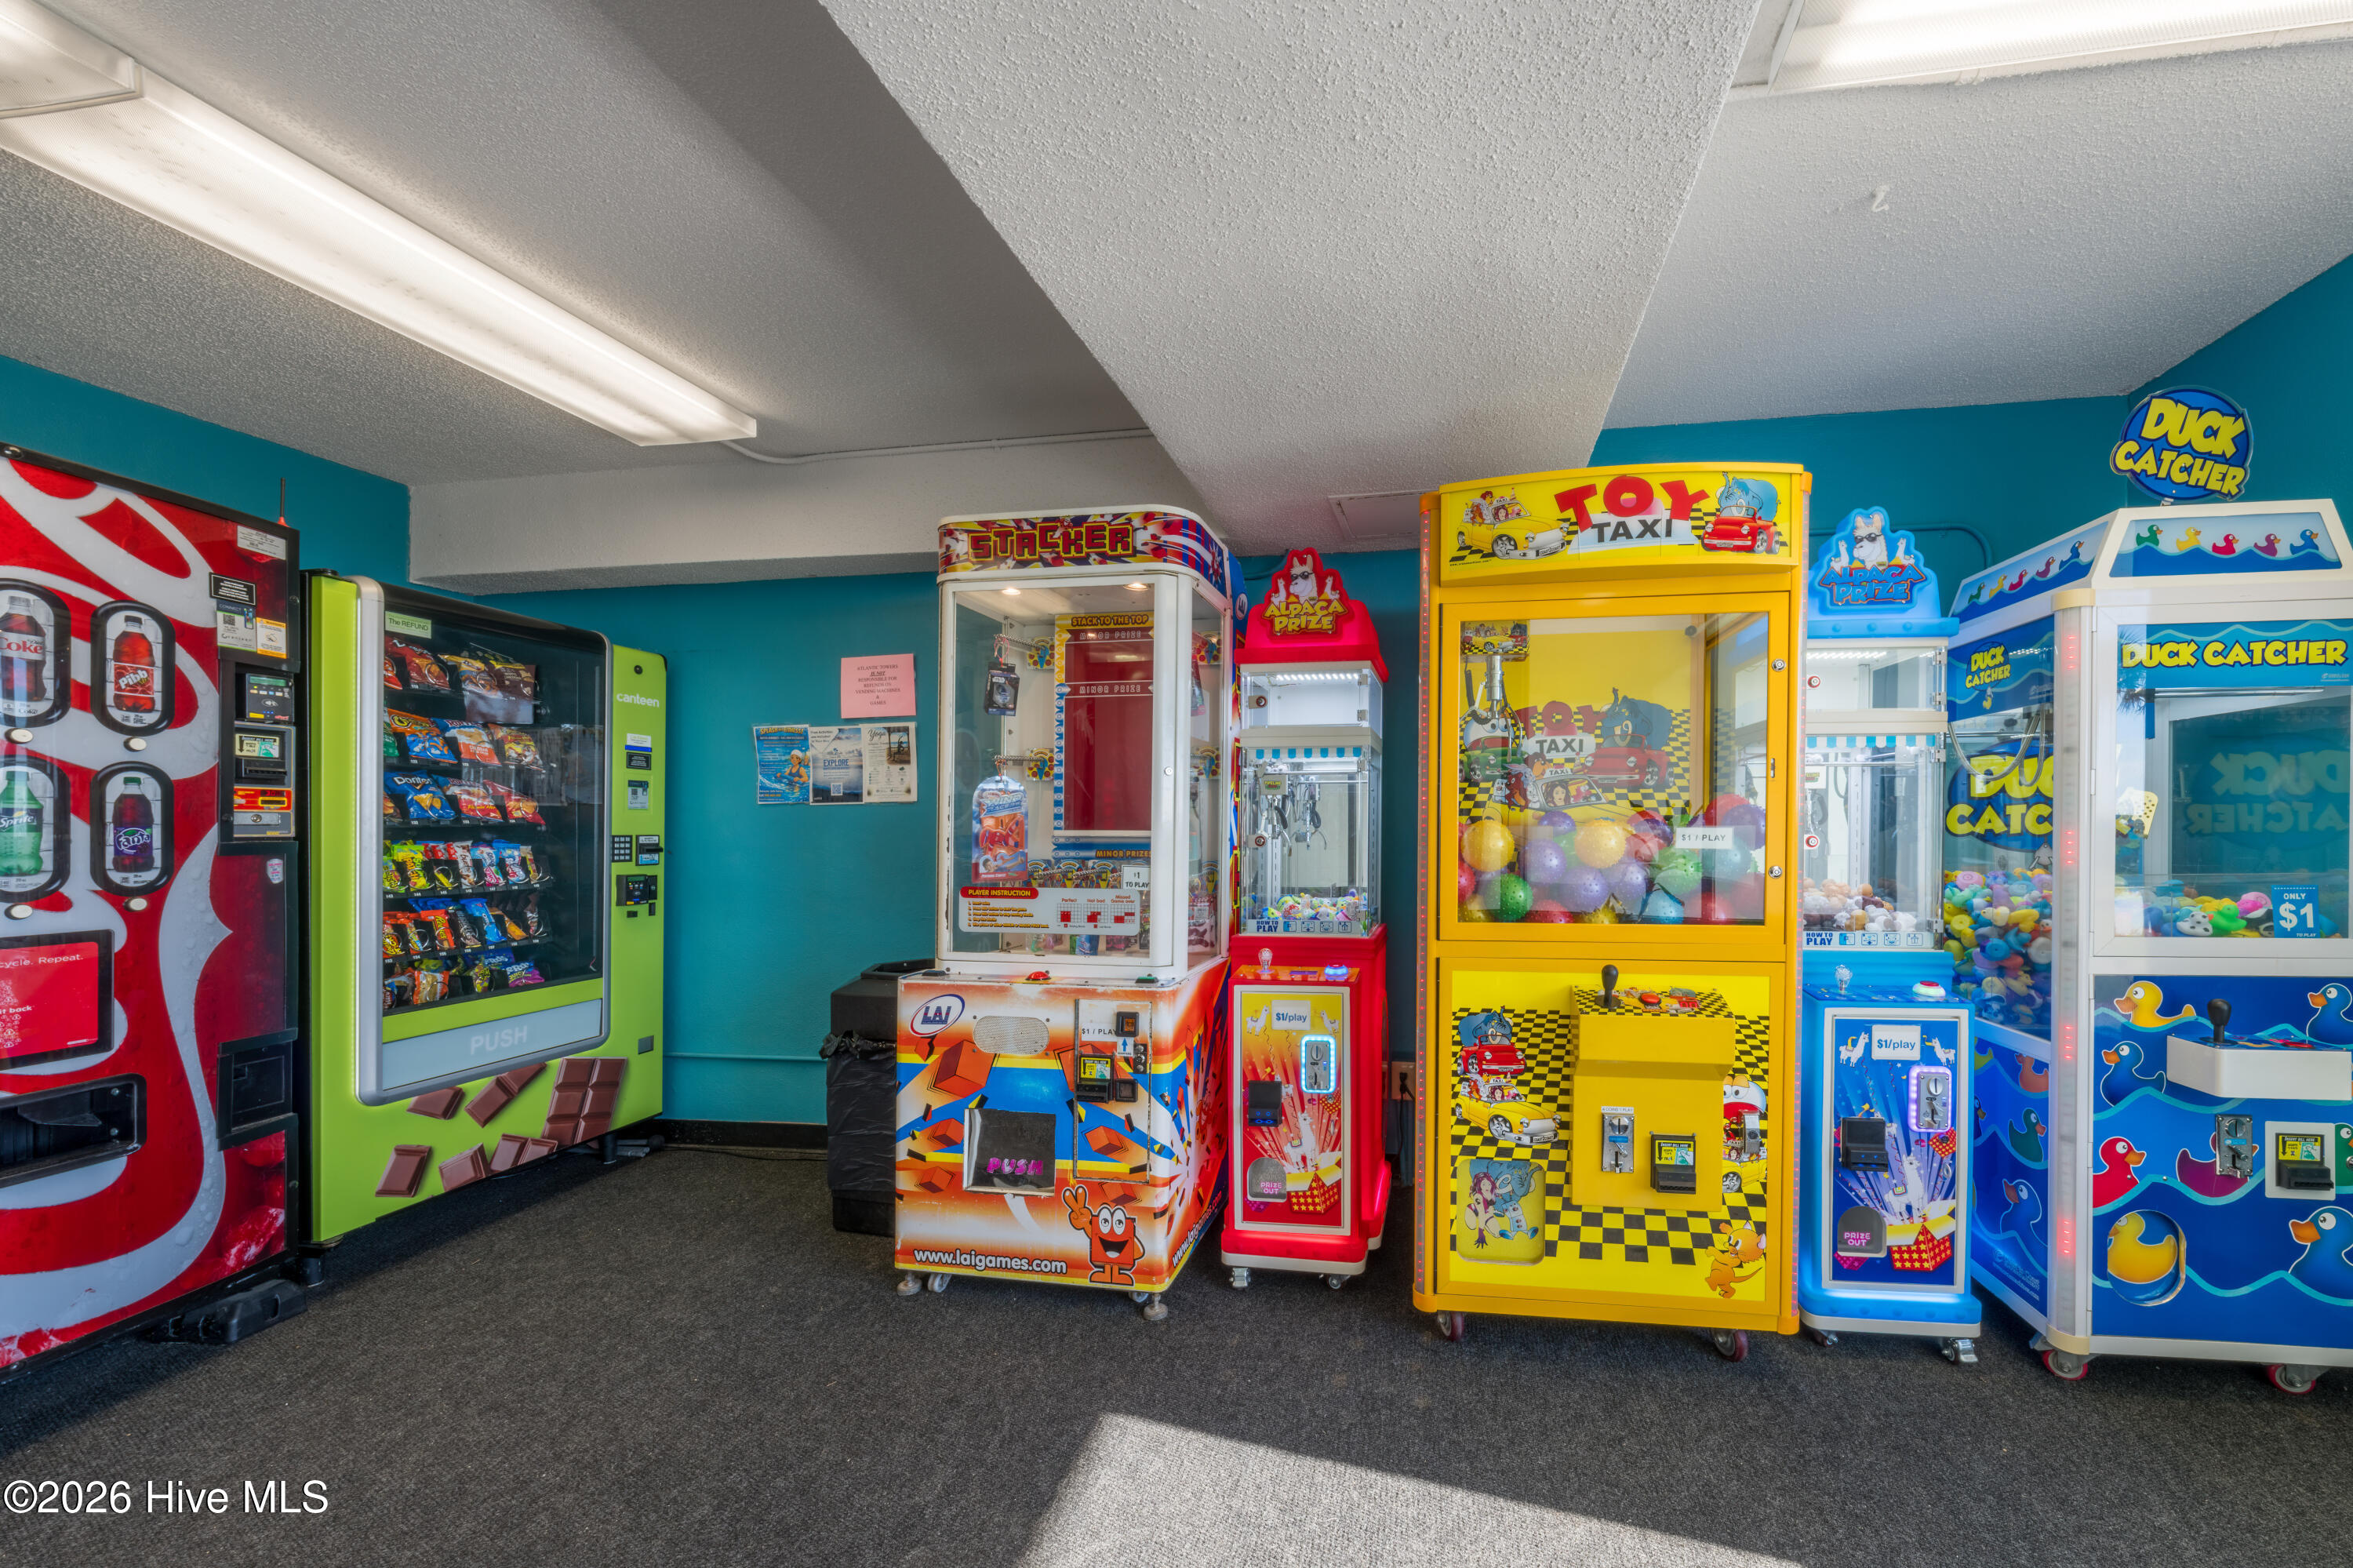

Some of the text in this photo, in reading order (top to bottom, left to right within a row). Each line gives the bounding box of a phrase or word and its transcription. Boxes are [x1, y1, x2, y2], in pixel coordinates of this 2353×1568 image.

[2141, 398, 2246, 458] DUCK
[2115, 440, 2249, 497] CATCHER
[1554, 475, 1710, 531] TOY
[1592, 518, 1674, 544] TAXI
[969, 522, 1134, 562] STACKER
[1820, 564, 1926, 587] ALPACA
[1835, 581, 1910, 603] PRIZE
[1263, 599, 1347, 618] ALPACA
[389, 617, 428, 631] The REFUND
[1071, 614, 1149, 627] STACK TO THE TOP
[1274, 614, 1334, 632] PRIZE
[1970, 645, 2005, 672] DUCK
[2122, 640, 2348, 668] DUCK CATCHER
[118, 669, 148, 689] Pibb
[1966, 664, 2011, 689] CATCHER
[1115, 684, 1141, 693] PRIZE
[616, 693, 660, 708] canteen
[867, 729, 886, 741] Yoga
[1536, 739, 1584, 754] TAXI
[0, 813, 35, 828] Sprite
[118, 832, 151, 849] Fanta
[1096, 849, 1124, 858] MINOR
[2278, 902, 2315, 931] $1
[38, 954, 84, 964] Repeat.
[9, 1005, 32, 1013] back
[921, 1006, 952, 1025] LAI
[1275, 1013, 1307, 1023] $1/play
[470, 1025, 529, 1054] PUSH
[1876, 1039, 1916, 1051] $1/play
[986, 1157, 1043, 1176] PUSH
[1172, 1190, 1222, 1268] www.laigames.com
[1844, 1231, 1871, 1240] PRIZE
[914, 1249, 1067, 1275] www.laigames.com
